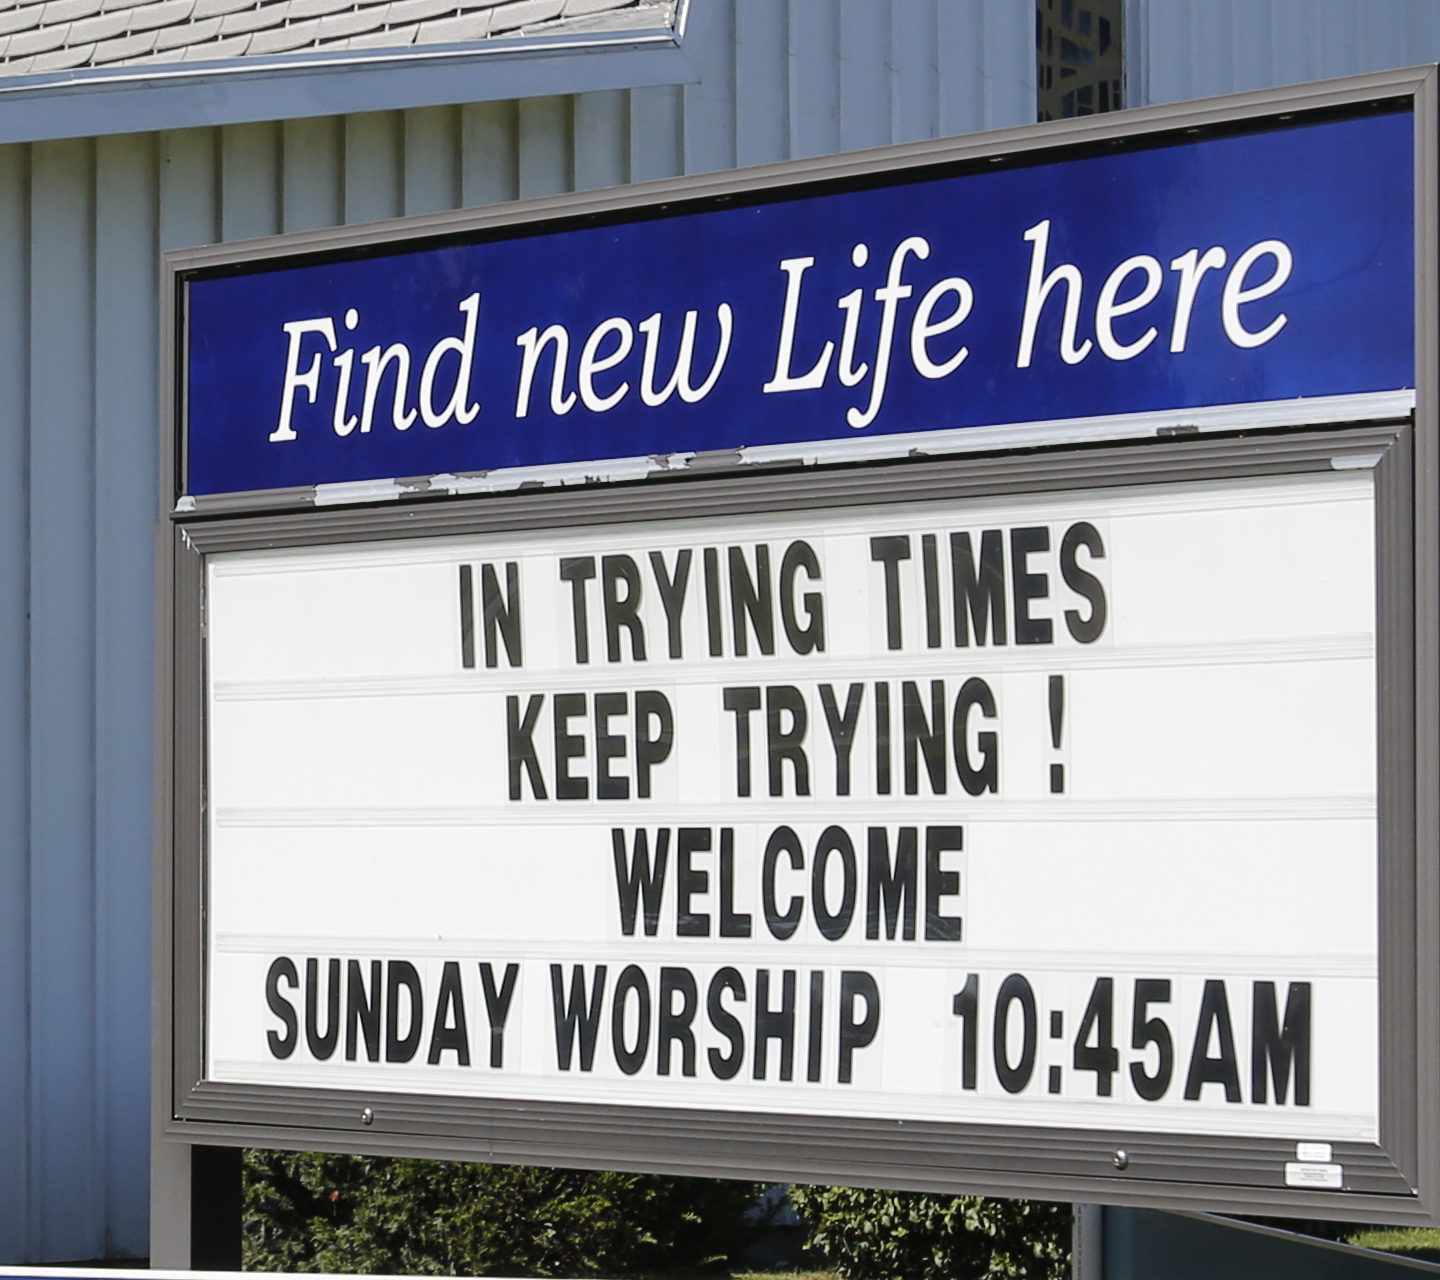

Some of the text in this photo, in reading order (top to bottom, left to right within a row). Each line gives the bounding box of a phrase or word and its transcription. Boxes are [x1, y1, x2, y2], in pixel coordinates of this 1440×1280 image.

[270, 220, 1292, 442] Find new Life here
[460, 522, 1106, 667] IN TRYING TIMES
[507, 691, 673, 800] KEEP
[724, 677, 997, 797] TRYING
[612, 826, 962, 941] WELCOME
[266, 957, 1310, 1106] SUNDAY WORSHIP 10:45AM
